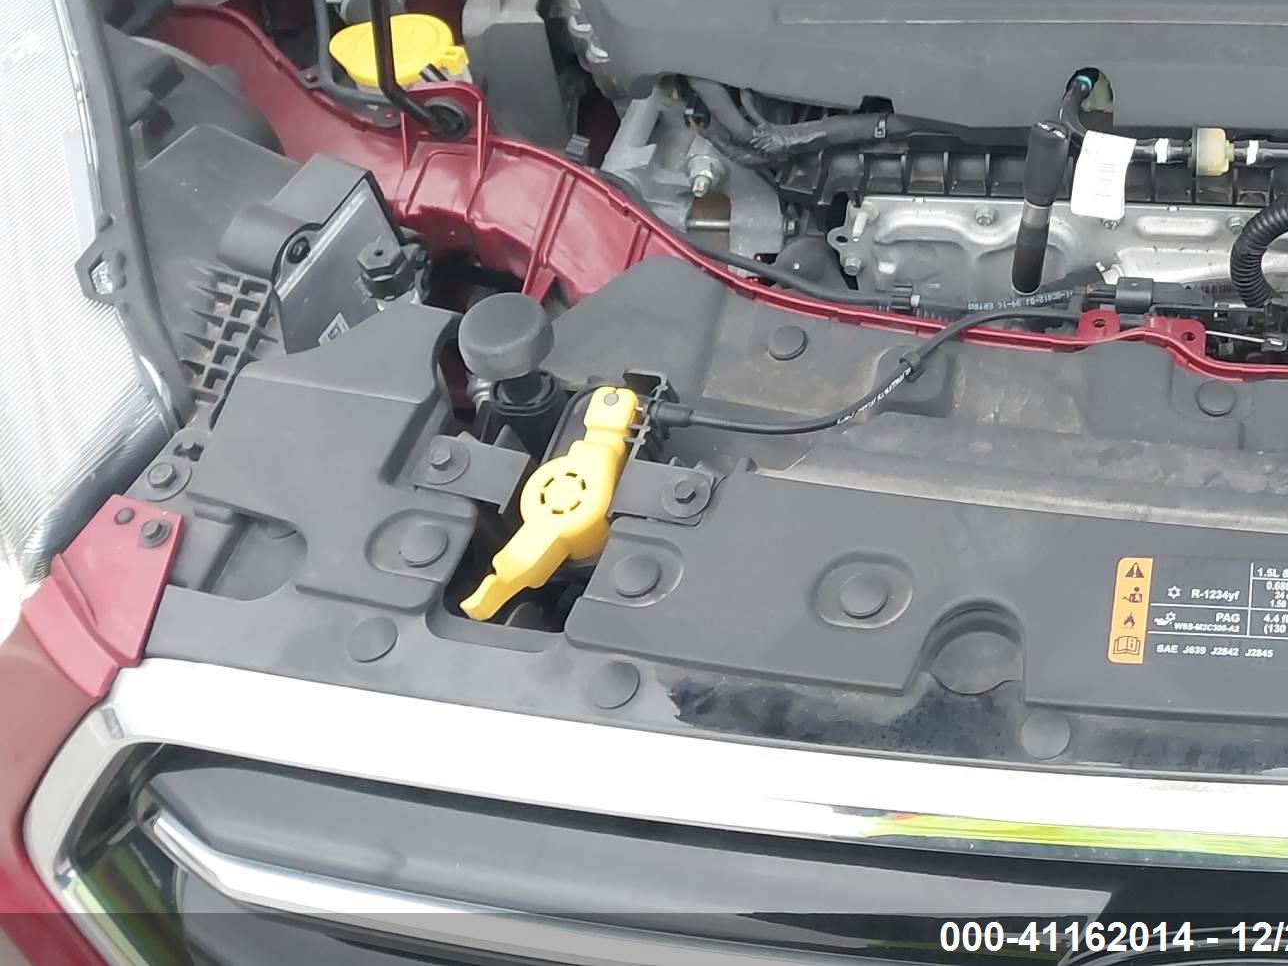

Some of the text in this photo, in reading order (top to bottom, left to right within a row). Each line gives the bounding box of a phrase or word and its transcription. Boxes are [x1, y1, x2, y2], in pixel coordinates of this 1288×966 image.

[1257, 567, 1280, 578] 1.5L
[1191, 588, 1241, 602] R-1234yf
[1274, 591, 1286, 600] 24
[1269, 599, 1287, 608] 1.50
[1215, 612, 1241, 623] PAG
[1263, 613, 1280, 624] 4.4
[1263, 623, 1287, 635] (130
[1156, 644, 1179, 654] SAE
[1210, 646, 1240, 656] J2842
[1244, 648, 1275, 658] J2845
